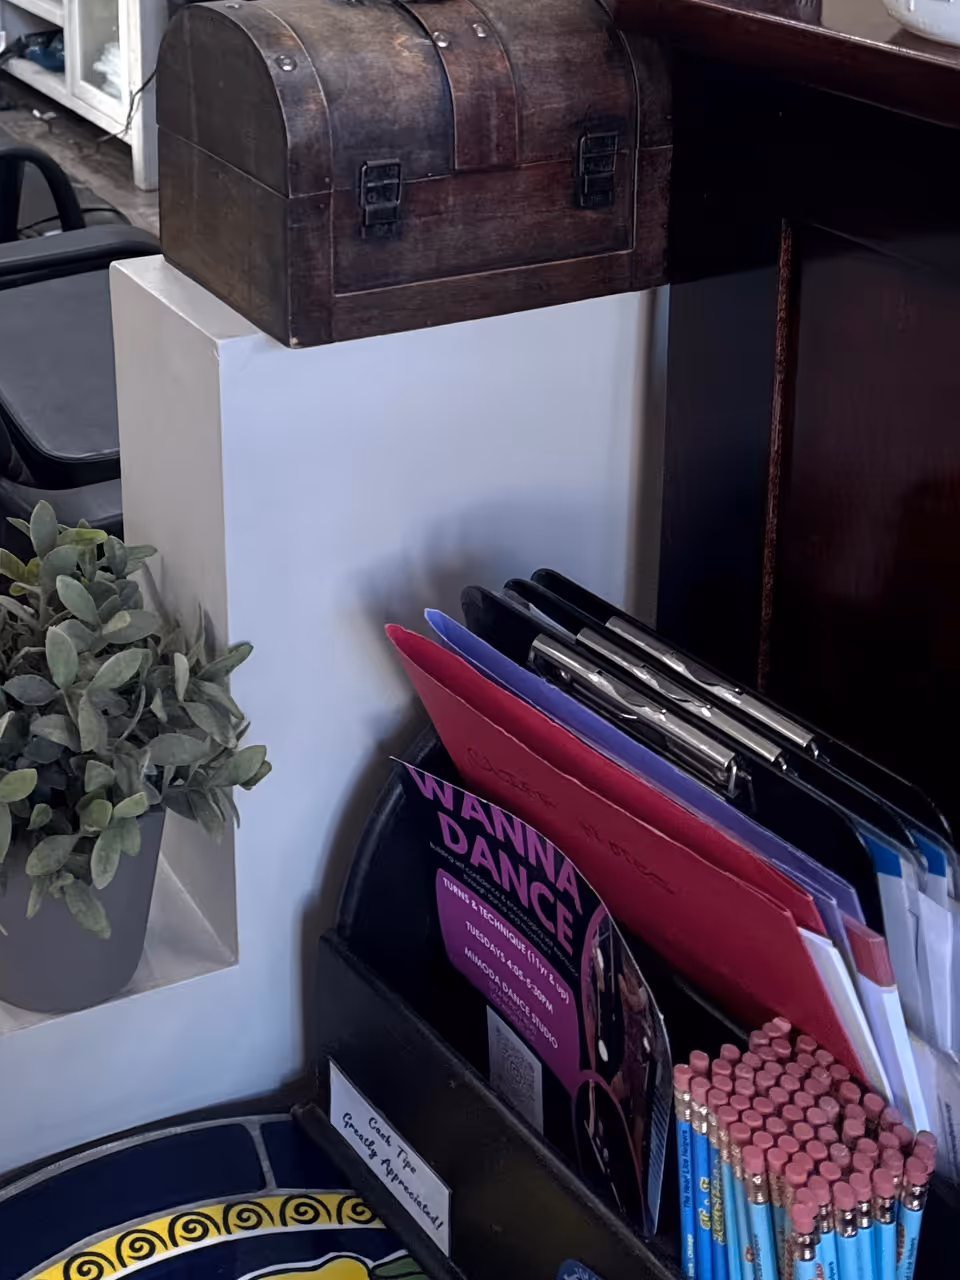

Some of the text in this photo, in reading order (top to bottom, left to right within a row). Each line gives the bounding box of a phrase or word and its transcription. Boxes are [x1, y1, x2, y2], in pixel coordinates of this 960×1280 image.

[406, 764, 583, 915] WANNA
[437, 811, 573, 956] DANCE
[442, 877, 470, 904] TURNS
[471, 899, 478, 911] &
[478, 905, 527, 955] TECHNIQUE
[548, 973, 555, 986] &
[556, 982, 570, 1004] up)
[464, 946, 501, 987] MIMODA
[502, 981, 530, 1017] DANCE
[531, 1012, 559, 1049] STUDIO
[465, 921, 506, 963] TUESDAYS
[342, 1112, 444, 1231] Greatly Appreciated!
[368, 1116, 393, 1148] Cash
